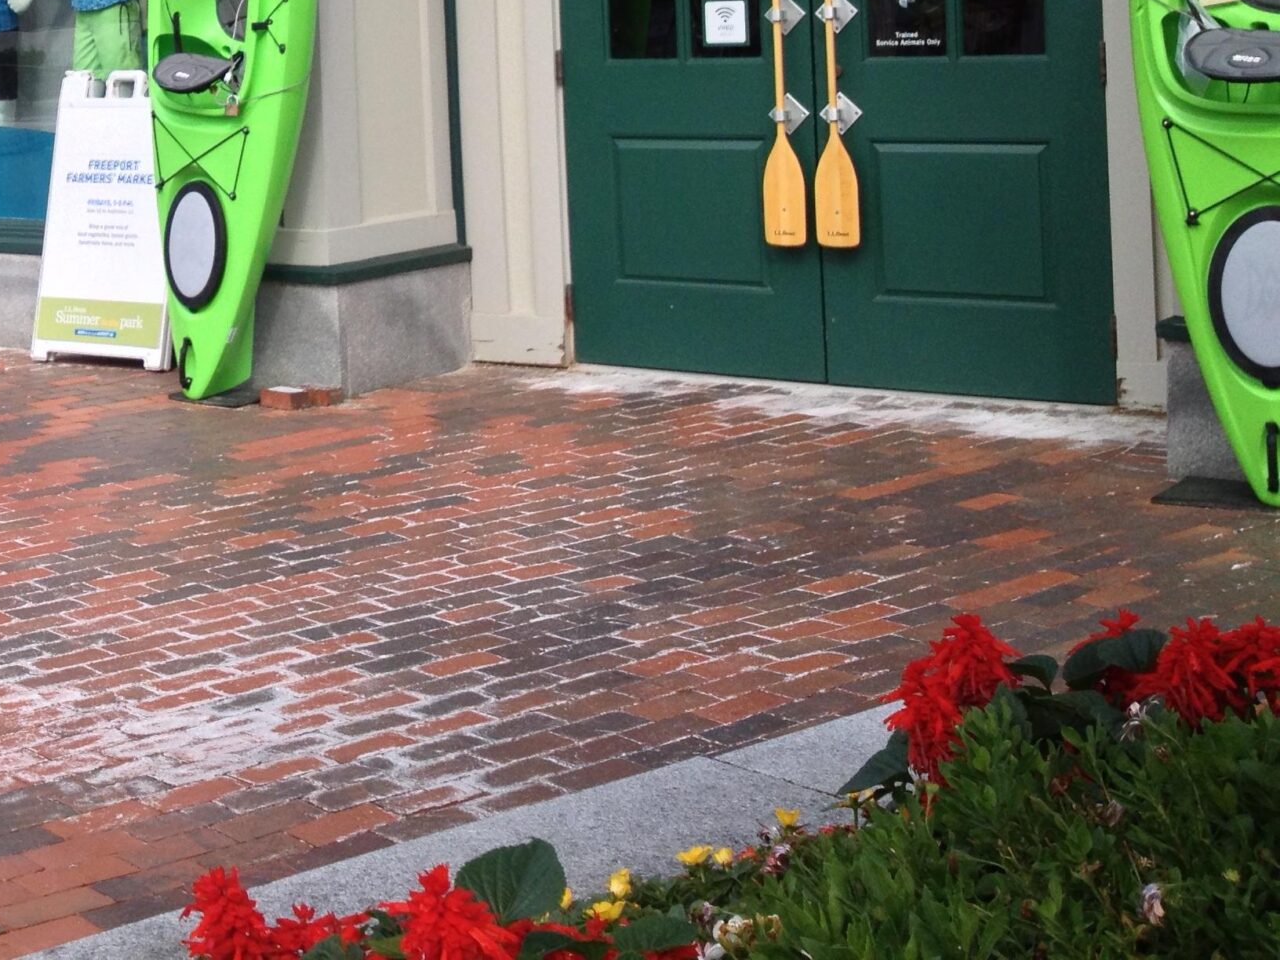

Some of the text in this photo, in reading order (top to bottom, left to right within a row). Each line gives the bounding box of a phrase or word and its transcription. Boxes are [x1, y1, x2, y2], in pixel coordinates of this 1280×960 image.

[88, 159, 141, 171] FREEPORT
[117, 173, 154, 185] MARKE
[56, 309, 101, 326] Summer
[119, 315, 144, 330] park
